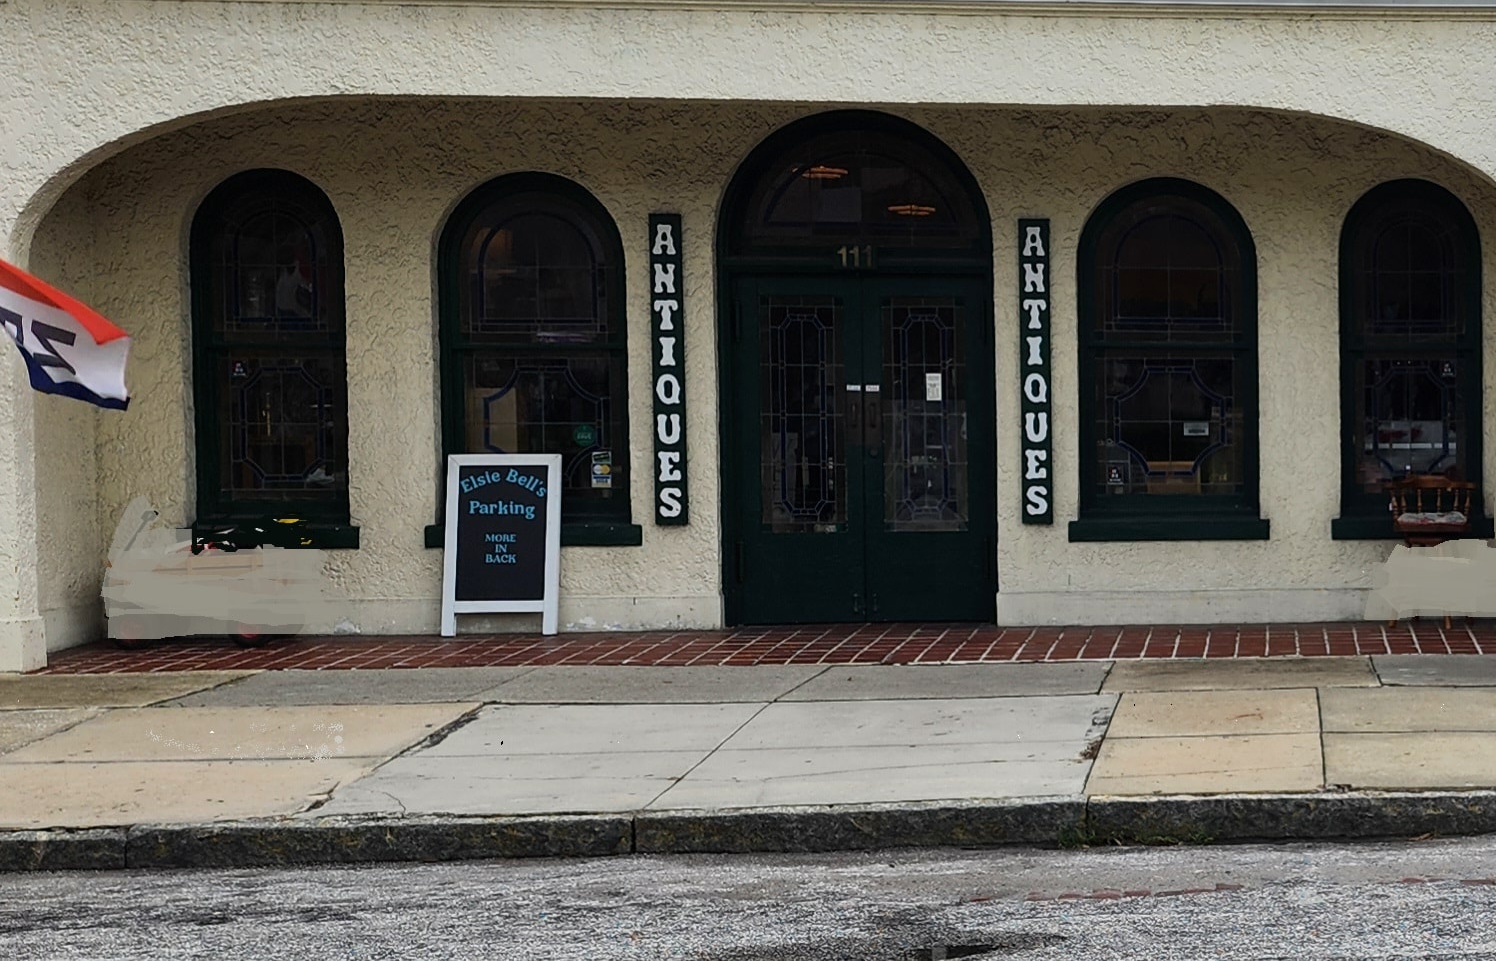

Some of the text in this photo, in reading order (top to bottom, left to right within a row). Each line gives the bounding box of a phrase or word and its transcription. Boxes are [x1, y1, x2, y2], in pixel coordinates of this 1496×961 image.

[837, 245, 873, 268] 111
[652, 224, 684, 519] ANTIQUES
[1022, 226, 1049, 517] ANTIQUES
[460, 469, 547, 497] Elsie Bell's
[469, 501, 535, 519] Parking
[485, 555, 516, 563] BACK
[496, 545, 507, 553] IN
